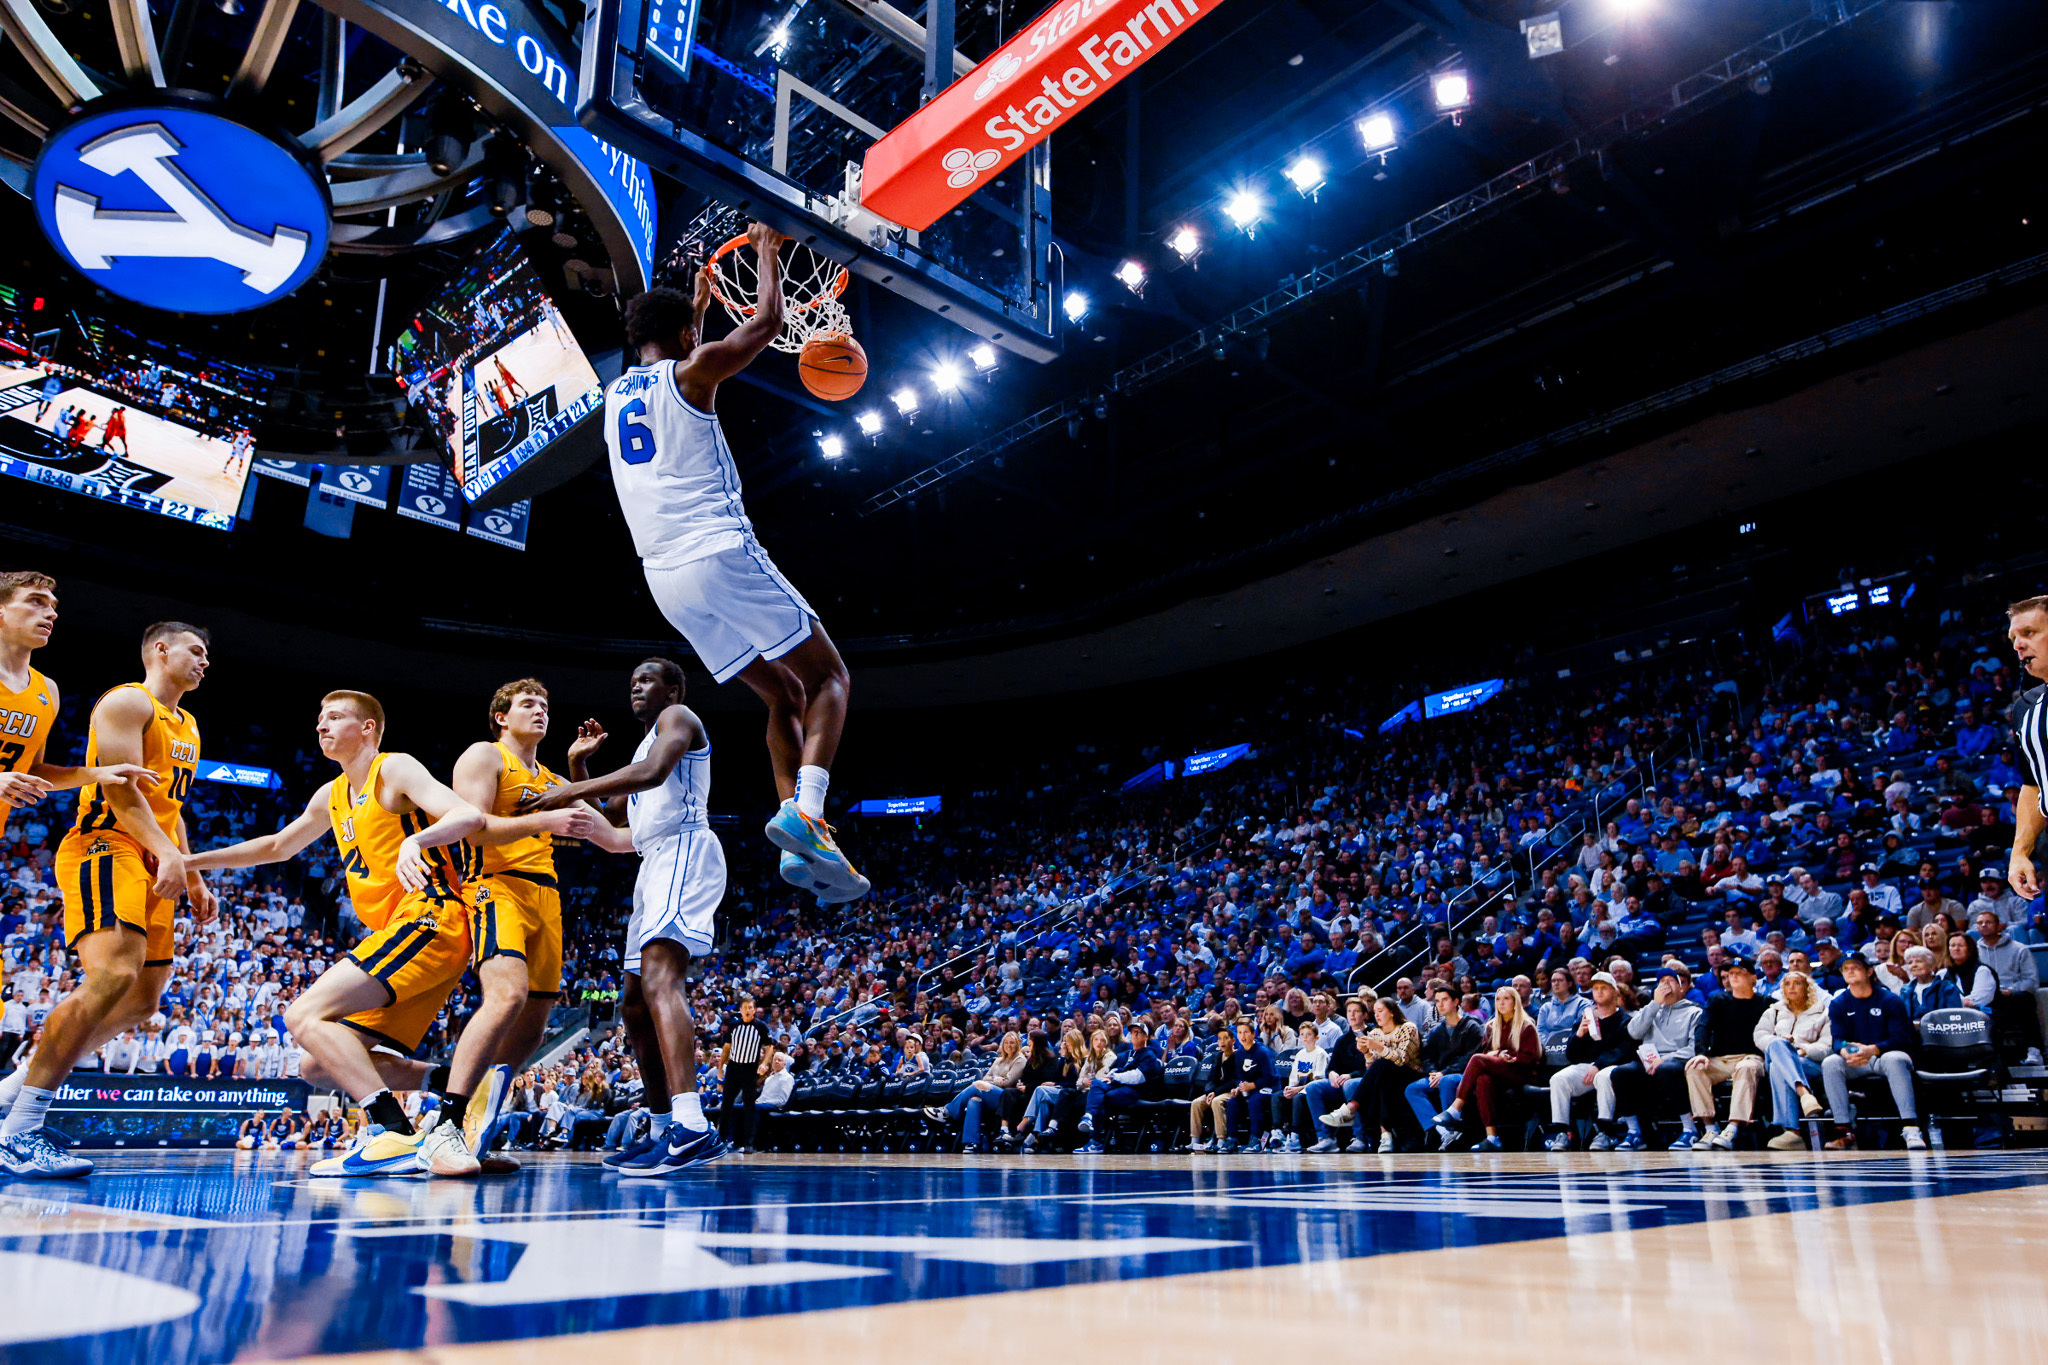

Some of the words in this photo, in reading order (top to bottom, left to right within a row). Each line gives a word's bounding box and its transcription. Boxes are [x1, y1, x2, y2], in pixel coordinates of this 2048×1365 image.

[517, 35, 567, 103] on
[54, 123, 308, 294] Y
[570, 402, 585, 420] 22
[618, 398, 657, 465] 6
[346, 474, 367, 490] Y
[36, 467, 73, 489] 13:49
[167, 502, 188, 519] 22
[421, 497, 441, 513] Y
[488, 517, 508, 533] Y
[170, 738, 197, 763] CCU
[167, 765, 193, 802] 10
[1927, 1020, 1986, 1032] SAPPHIRE
[1545, 1045, 1567, 1053] SAPP
[1164, 1066, 1192, 1074] SAPPHIRE
[1275, 1059, 1293, 1067] SAPP
[55, 1084, 93, 1100] ther
[96, 1088, 121, 1101] we
[123, 1088, 155, 1101] can
[157, 1086, 193, 1102] take
[195, 1088, 217, 1102] on
[218, 1087, 289, 1107] anything.
